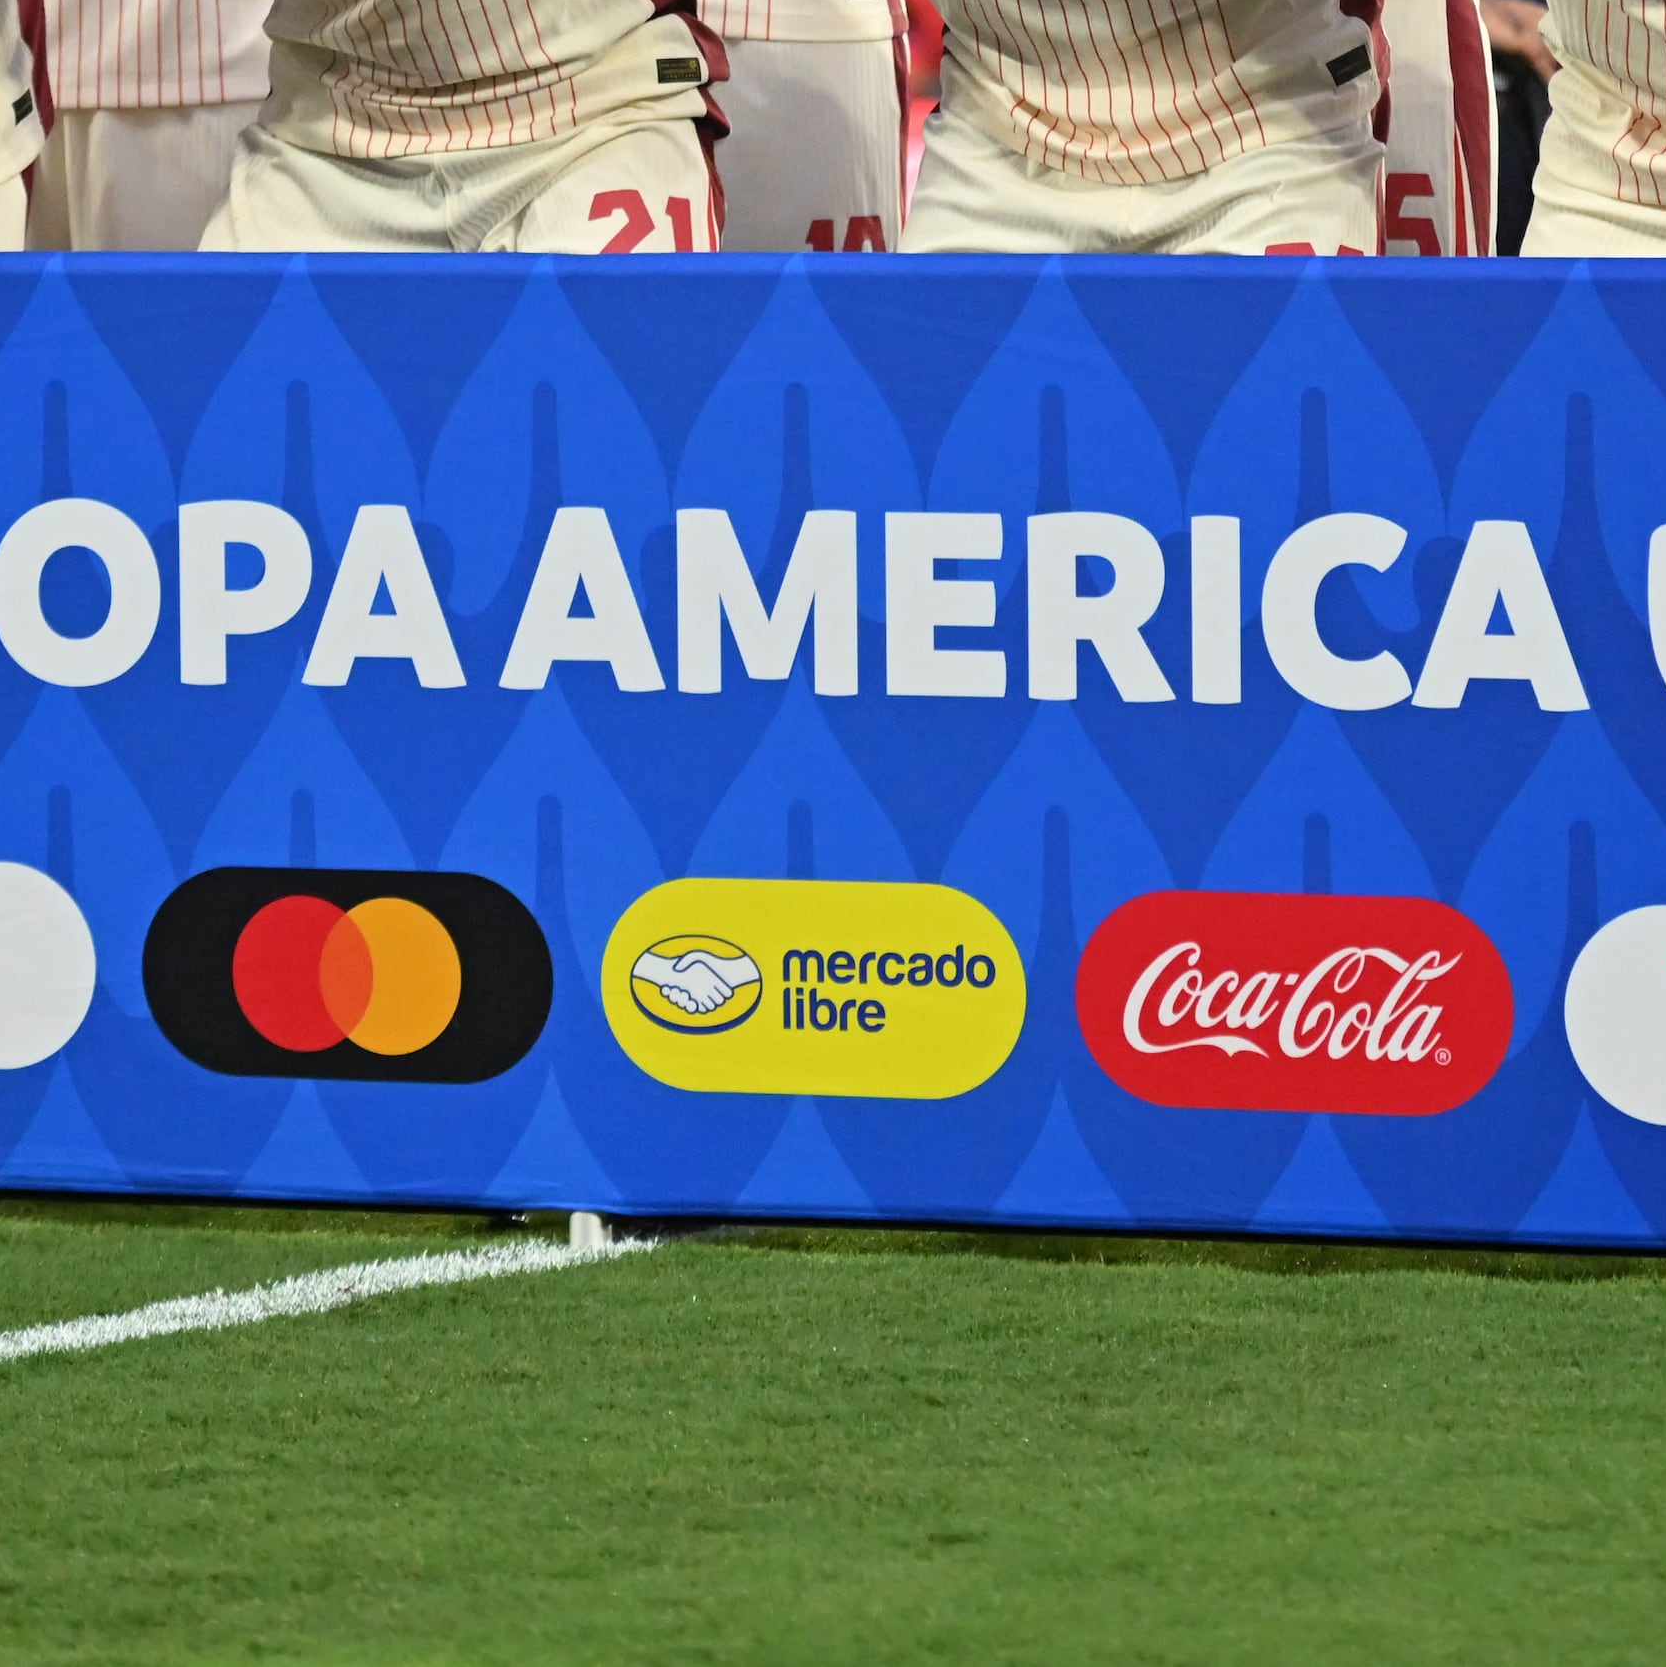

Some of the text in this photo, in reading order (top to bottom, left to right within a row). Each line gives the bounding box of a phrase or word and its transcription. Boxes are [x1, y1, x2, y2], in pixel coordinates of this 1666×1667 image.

[499, 507, 1590, 713] AMERICA
[783, 945, 996, 989] mercado
[1123, 941, 1464, 1063] Coca-Cola
[783, 988, 886, 1033] libre
